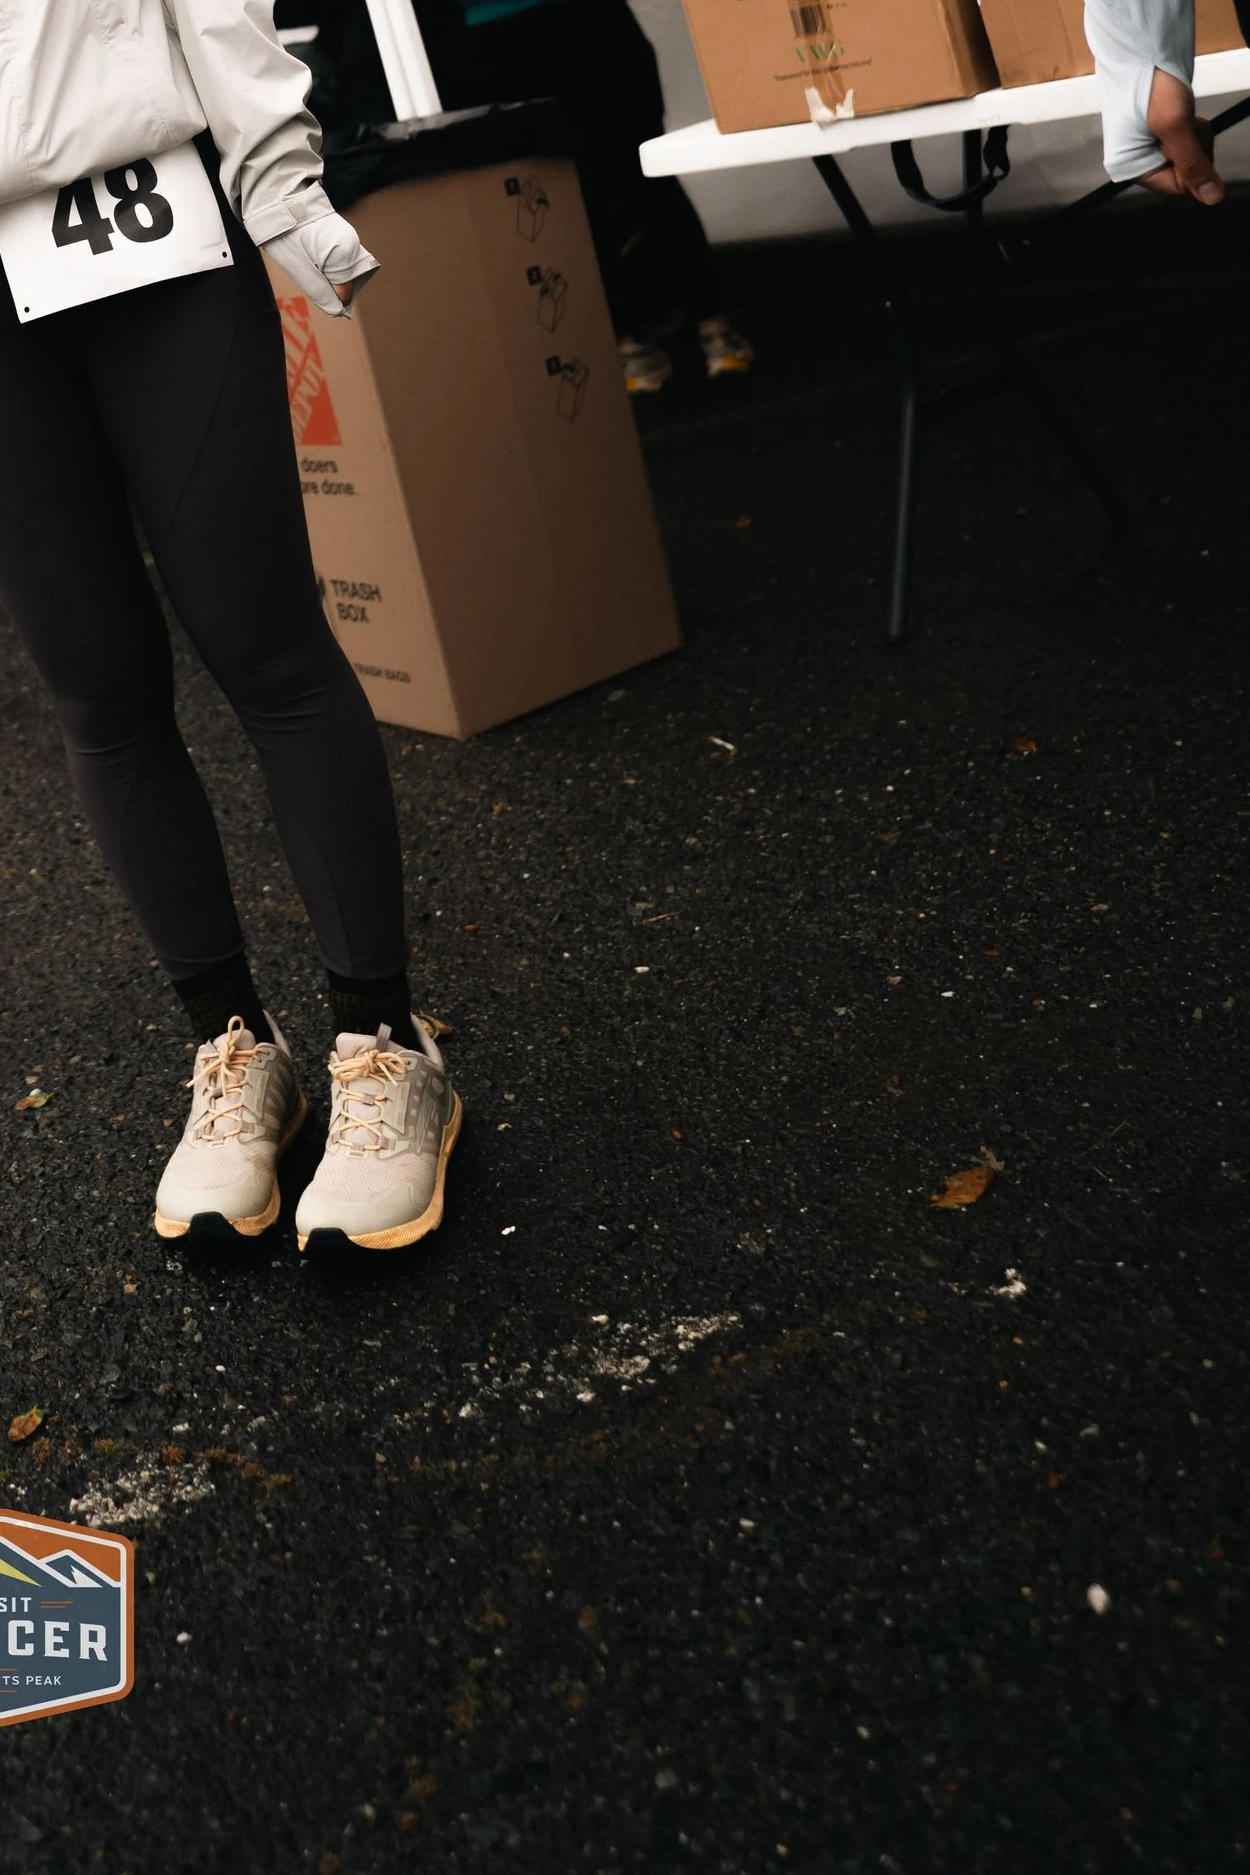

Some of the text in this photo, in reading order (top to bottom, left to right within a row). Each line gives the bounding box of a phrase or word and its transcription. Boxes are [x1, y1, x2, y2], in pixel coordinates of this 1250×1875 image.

[52, 157, 174, 256] 48
[300, 481, 320, 495] ore
[330, 578, 382, 602] TRASH
[336, 602, 370, 623] BOX
